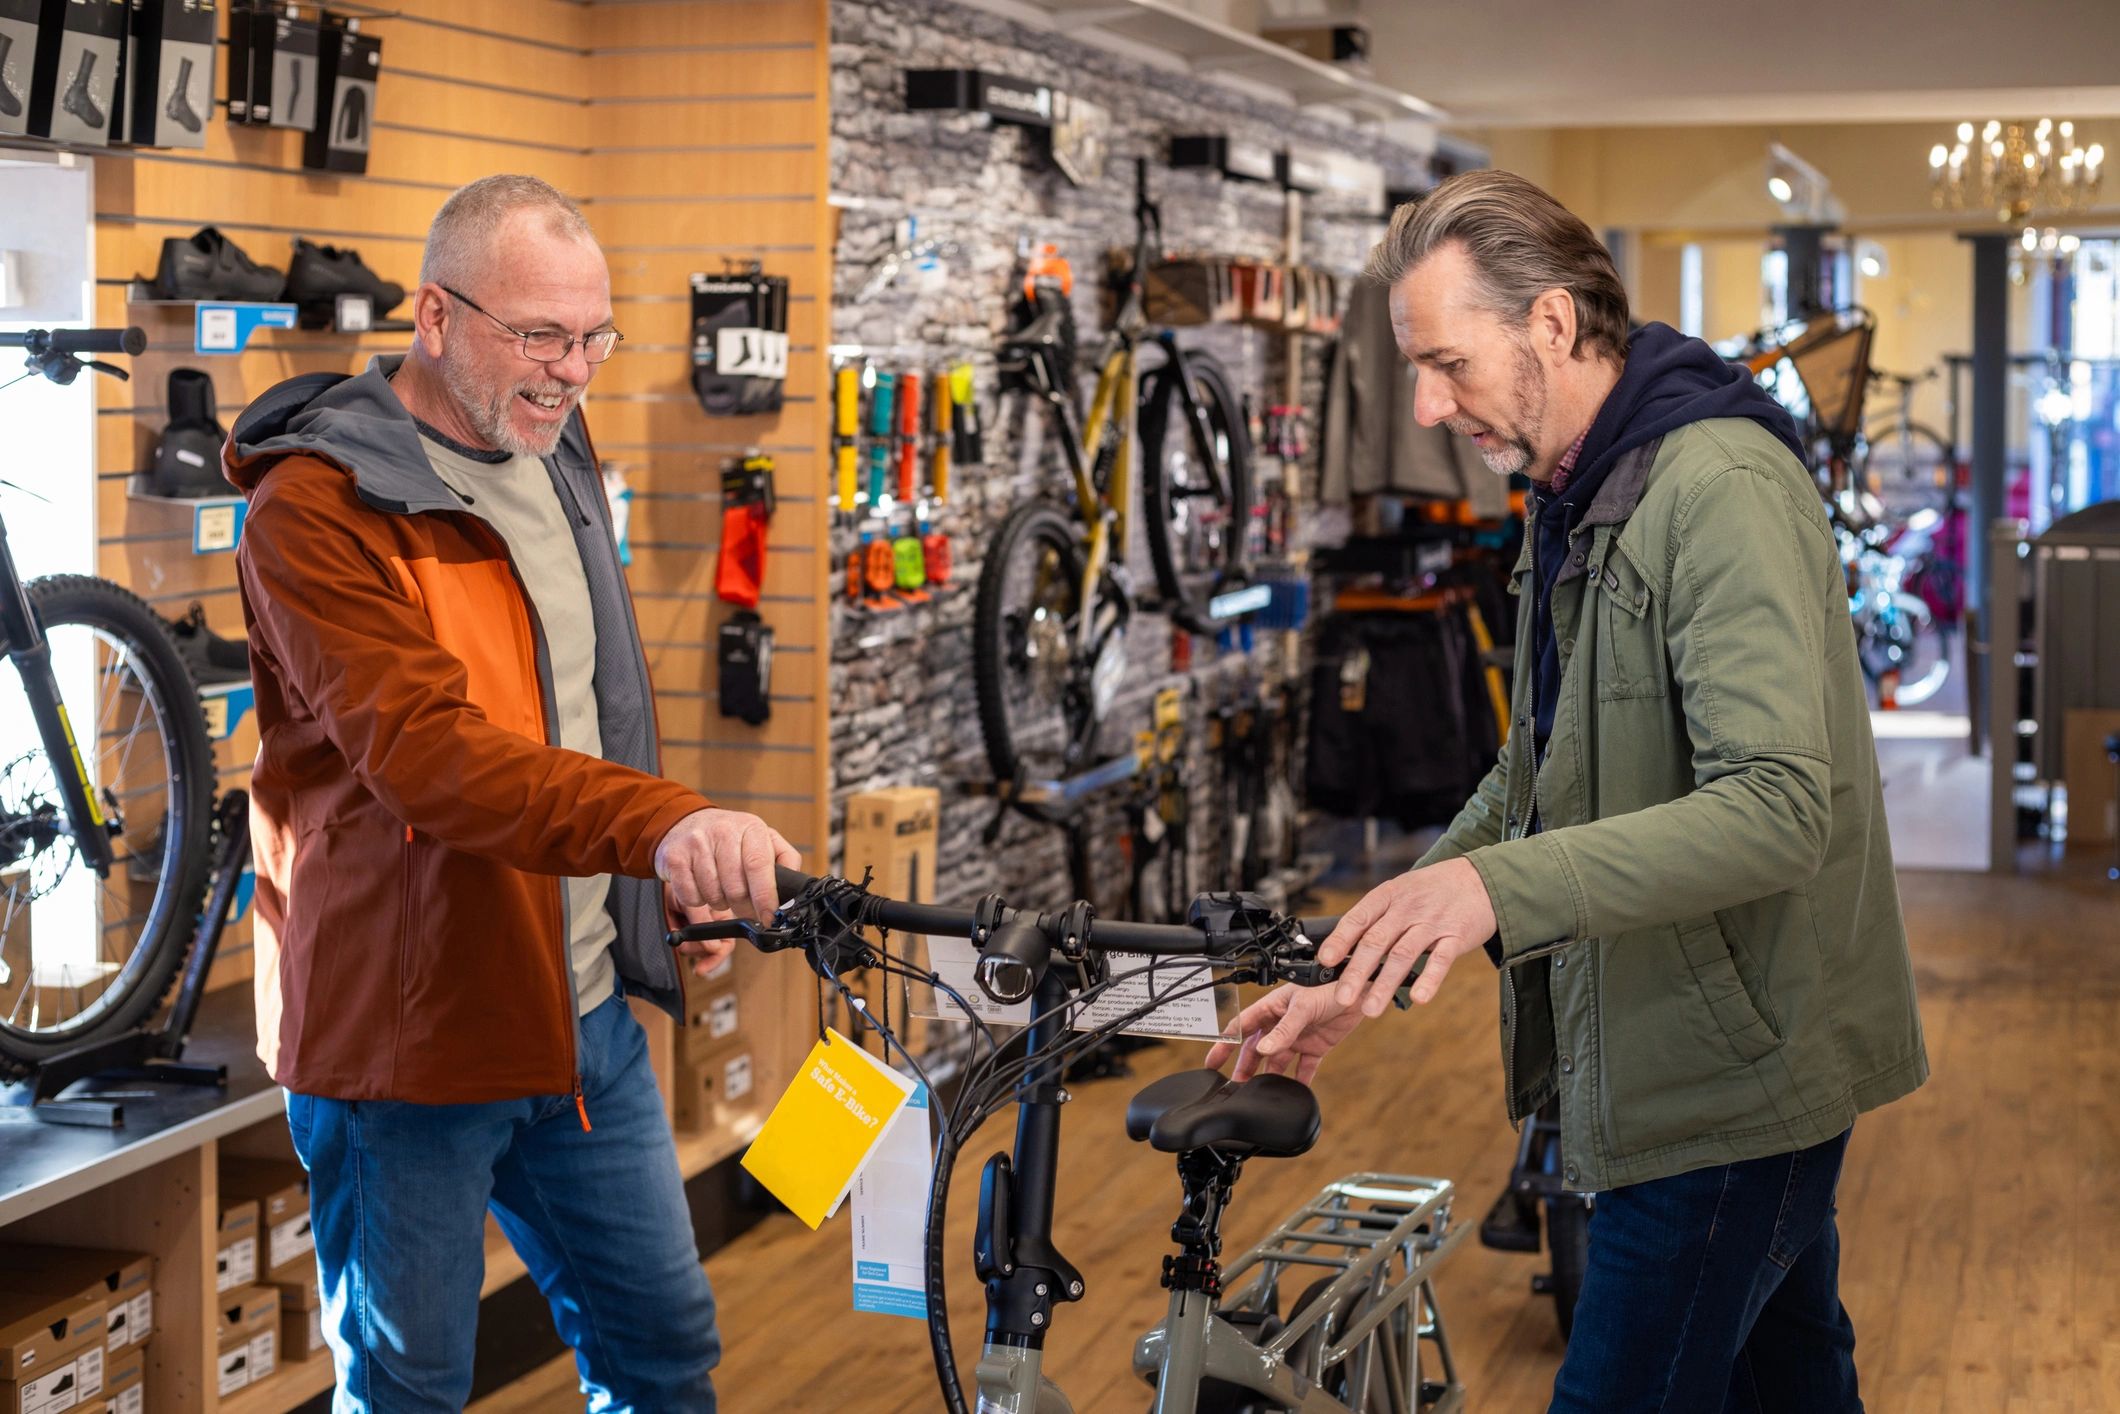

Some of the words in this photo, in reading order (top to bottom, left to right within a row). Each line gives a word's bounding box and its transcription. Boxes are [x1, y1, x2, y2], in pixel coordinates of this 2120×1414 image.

[818, 1058, 835, 1076] What
[810, 1066, 836, 1093] Safe
[834, 1087, 880, 1129] E-Bike?
